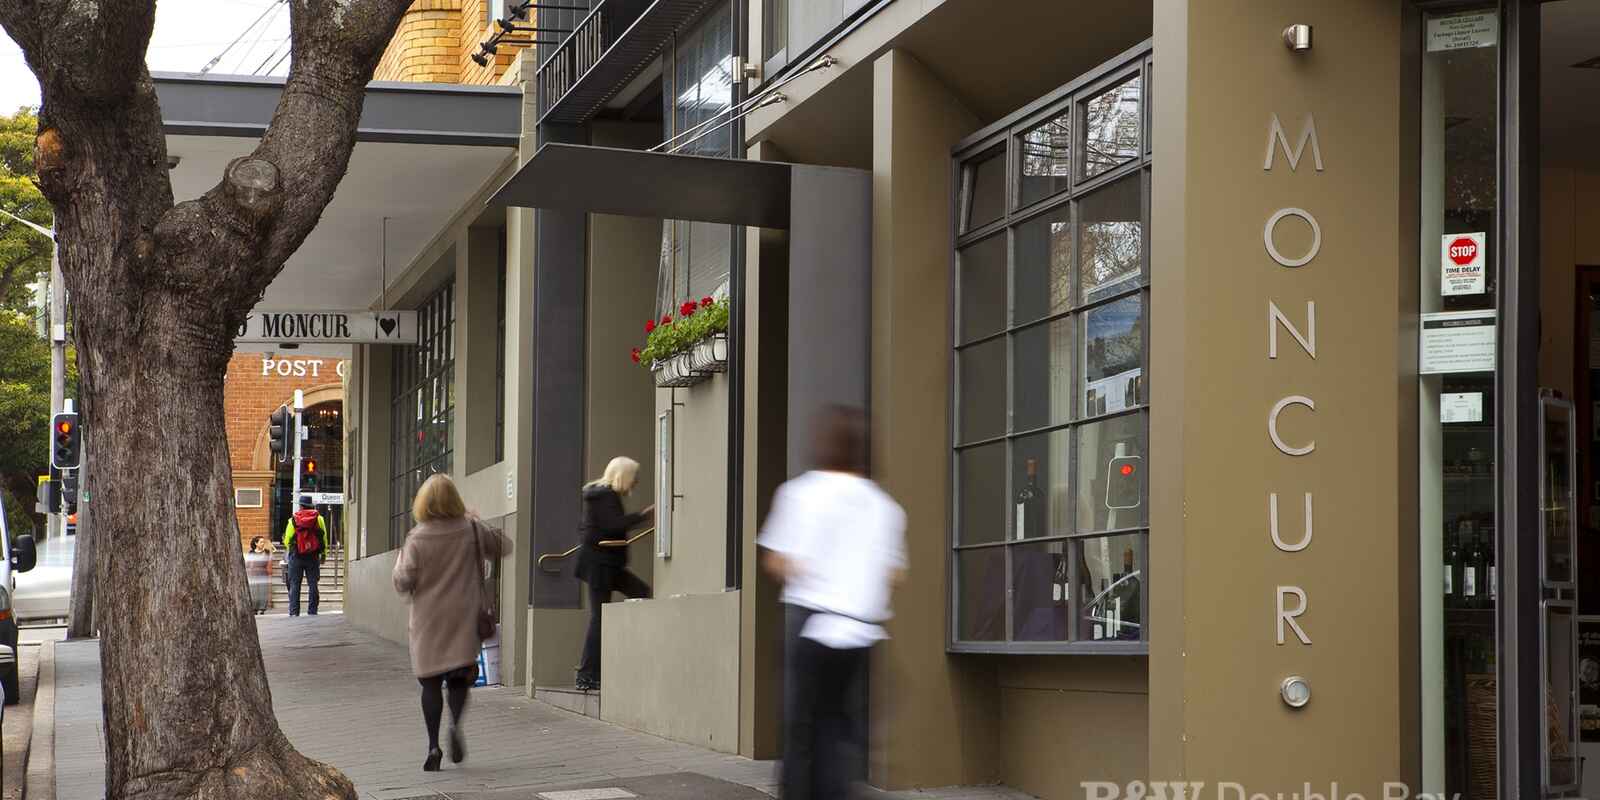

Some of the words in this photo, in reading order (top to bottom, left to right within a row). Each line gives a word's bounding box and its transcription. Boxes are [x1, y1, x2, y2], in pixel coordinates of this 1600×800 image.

[1451, 245, 1476, 257] STOP
[262, 313, 351, 338] MONCUR
[261, 359, 323, 376] POST
[1263, 111, 1324, 645] MONCUR
